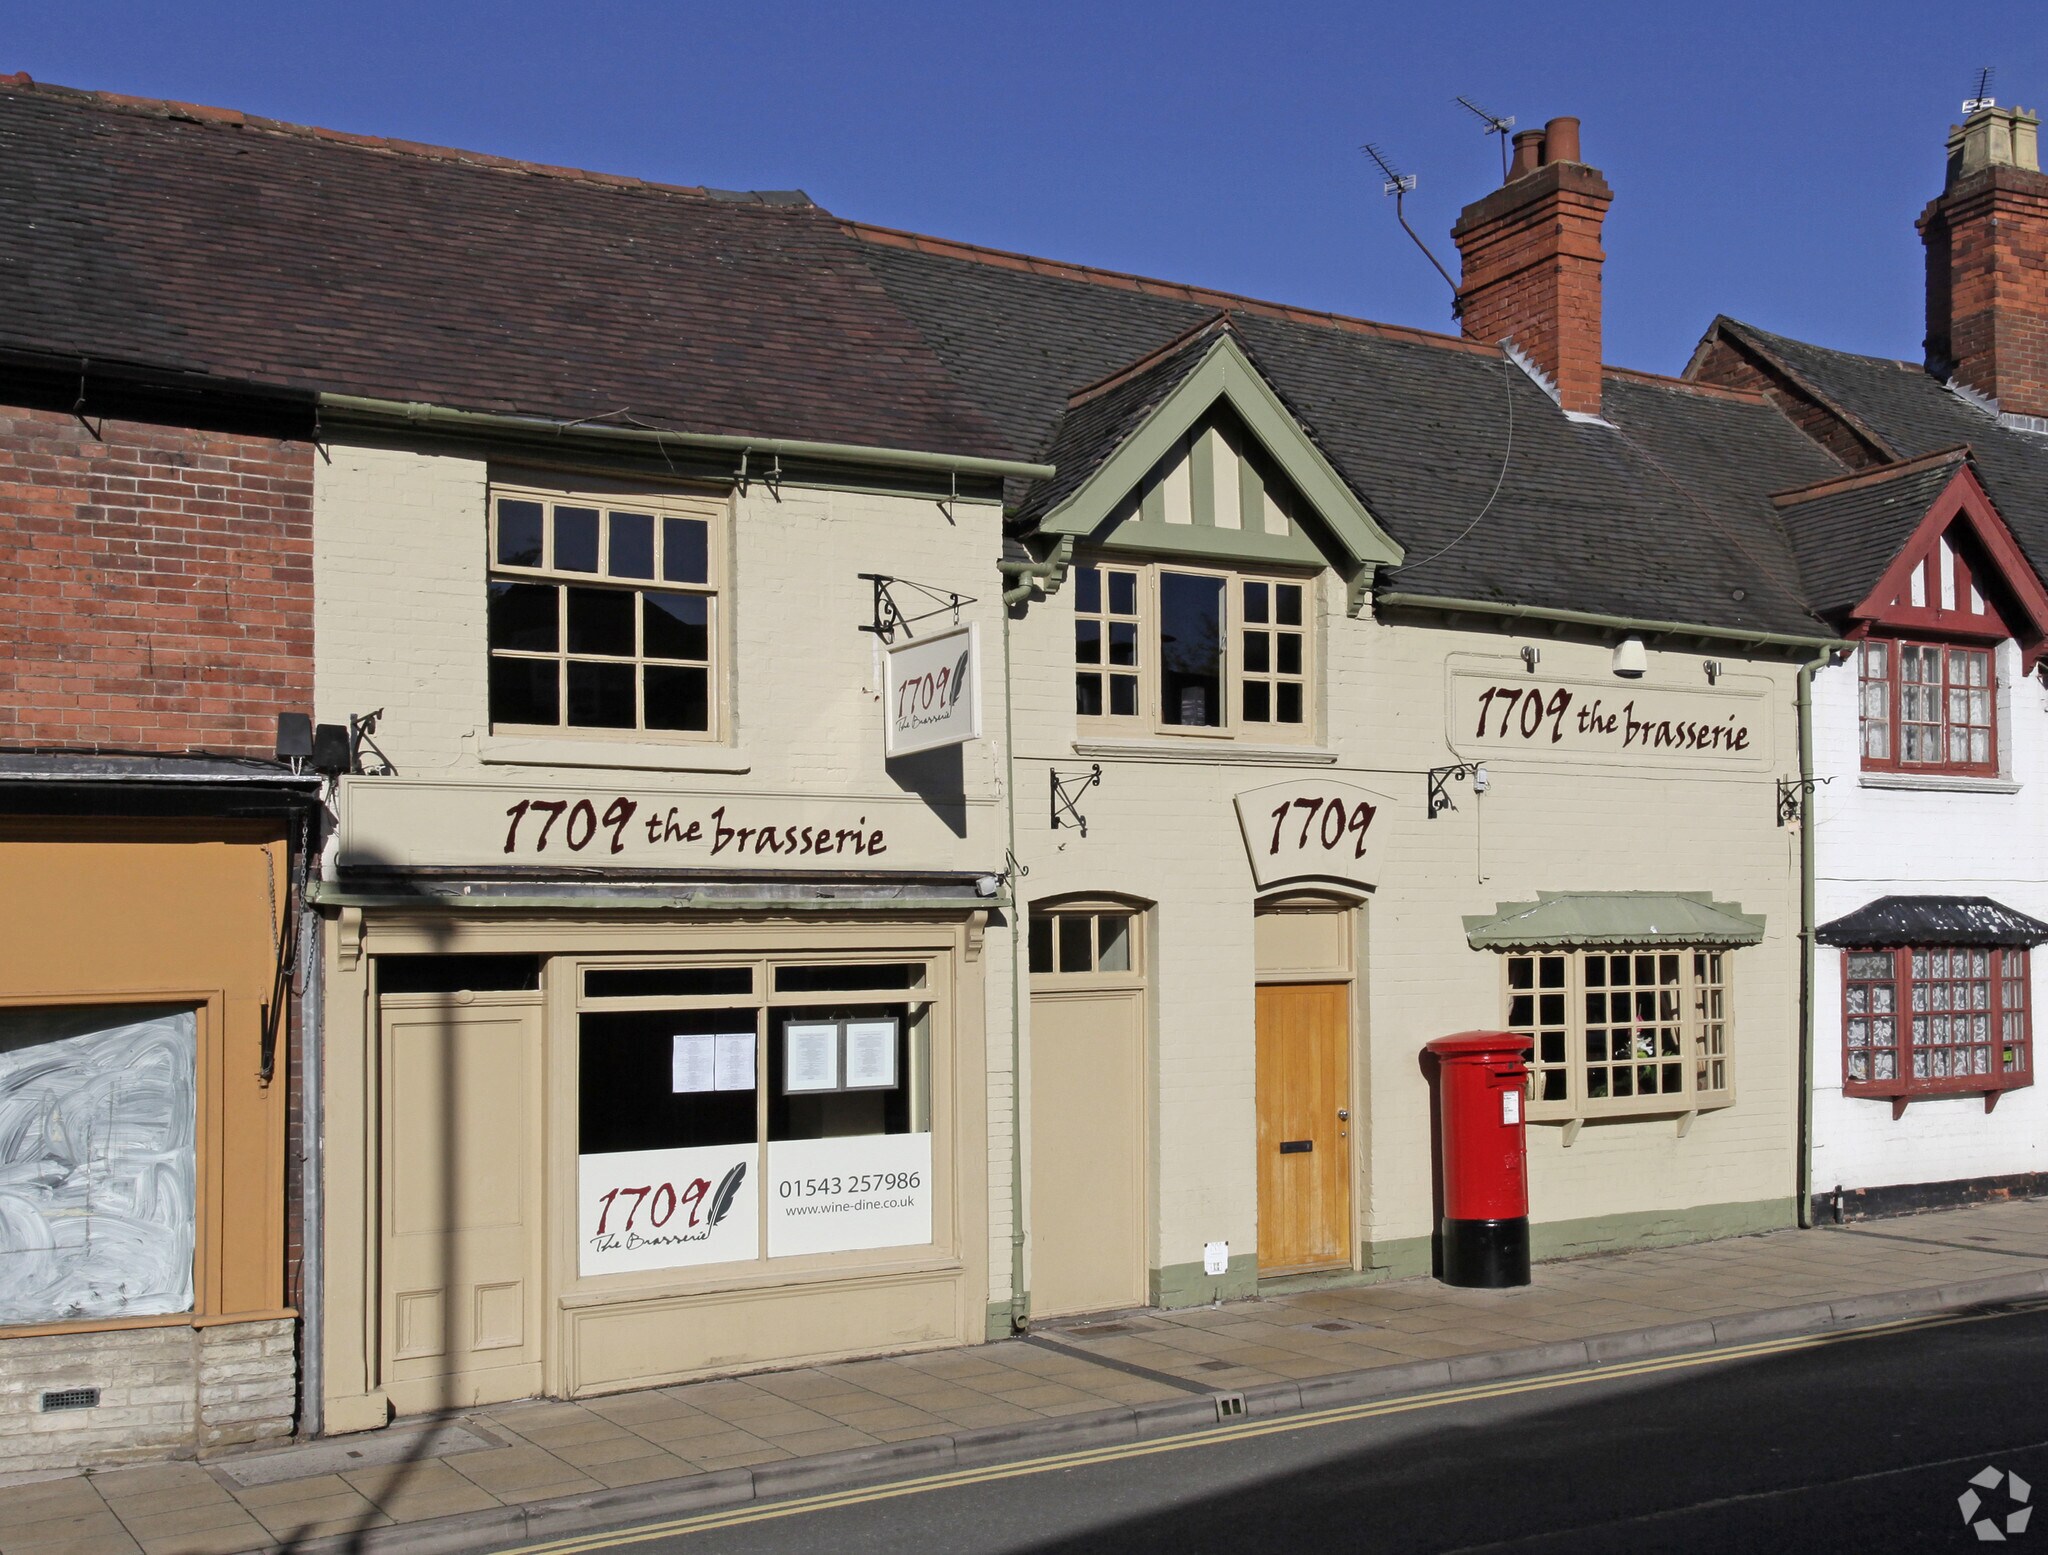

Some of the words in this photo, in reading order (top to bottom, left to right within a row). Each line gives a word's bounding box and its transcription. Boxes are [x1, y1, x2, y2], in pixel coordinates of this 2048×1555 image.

[898, 666, 951, 718] 1709
[895, 716, 910, 731] The
[912, 710, 951, 729] Brasserie
[1475, 686, 1574, 744] 1709
[1576, 699, 1619, 734] the
[1622, 700, 1750, 752] brasserie
[503, 796, 638, 855] 1709
[644, 806, 703, 844] the
[710, 805, 888, 857] brasserie
[1269, 796, 1377, 860] 1709
[596, 1177, 712, 1236] 1709
[779, 1176, 842, 1199] 01543
[847, 1171, 921, 1194] 257986
[785, 1195, 915, 1216] www.wine-dine.co.uk
[589, 1233, 622, 1253] The
[625, 1231, 709, 1251] Brasserie
